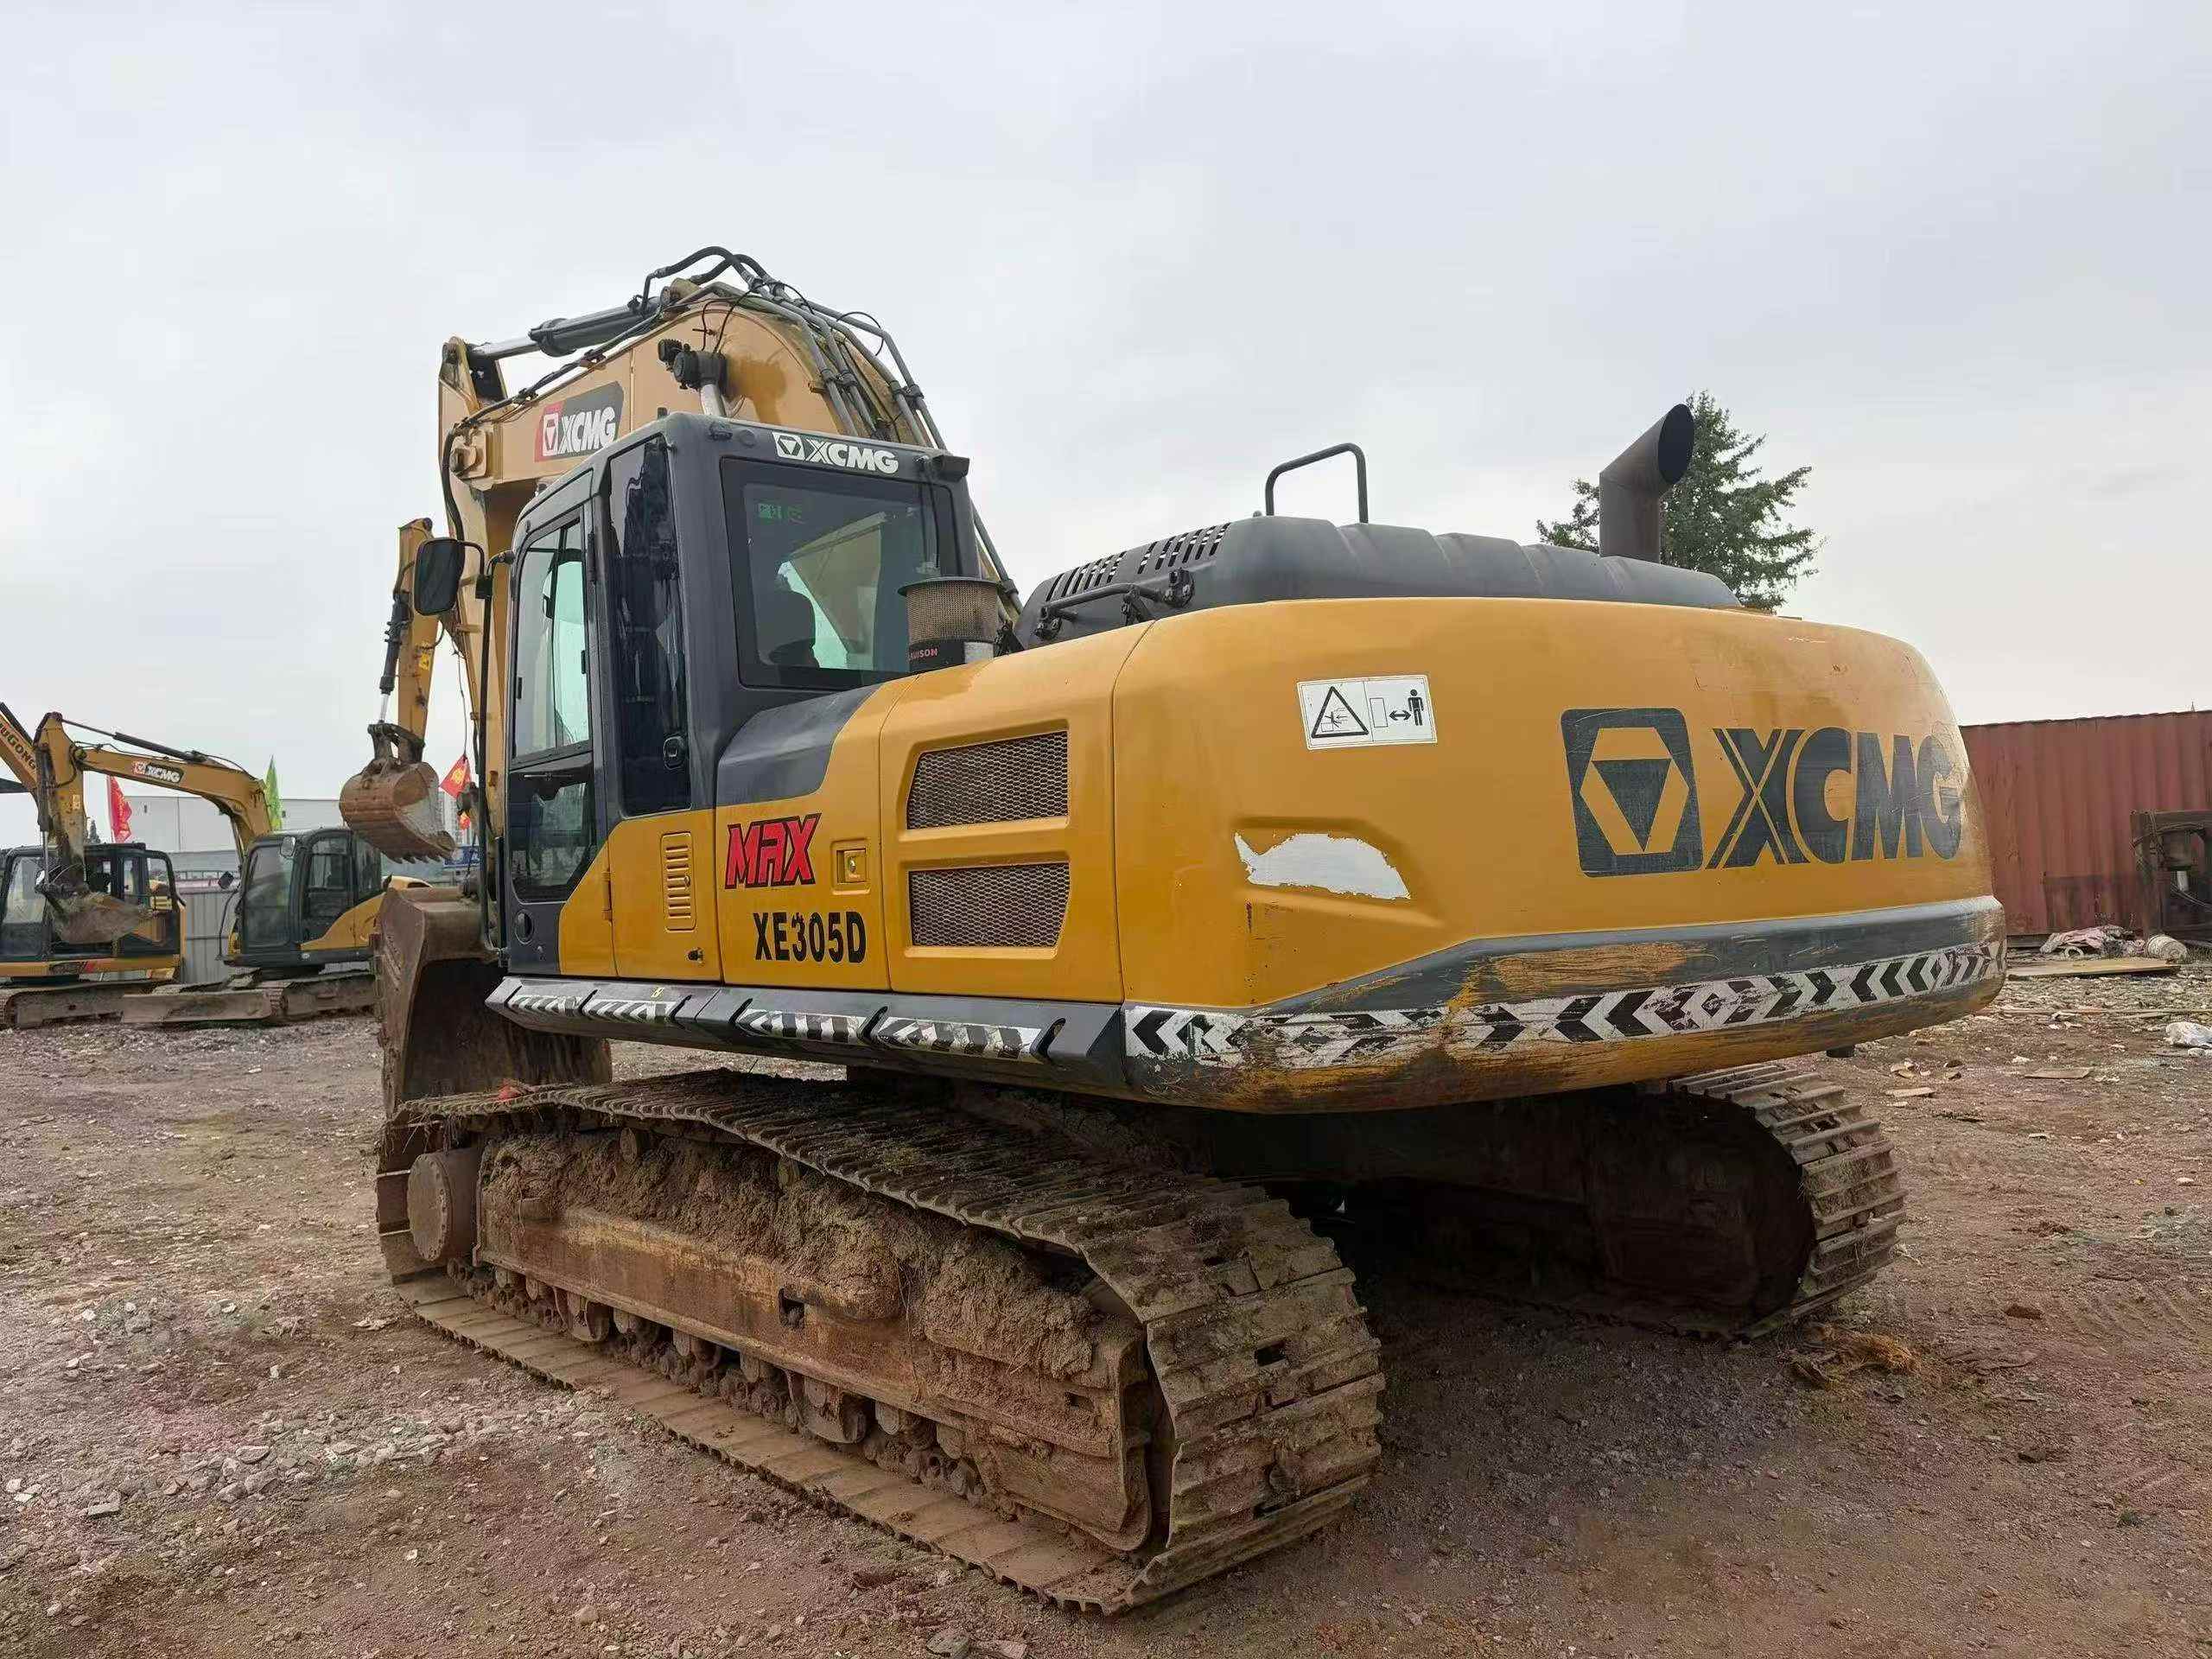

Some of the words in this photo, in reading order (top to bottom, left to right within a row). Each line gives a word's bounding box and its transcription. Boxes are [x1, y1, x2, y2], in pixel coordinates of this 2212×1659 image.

[557, 406, 616, 454] XCMG
[805, 438, 899, 474] XCMG
[0, 722, 36, 769] UGONG
[1704, 727, 1964, 869] XCMG
[724, 812, 823, 890] MAX
[753, 911, 867, 963] XE305D
